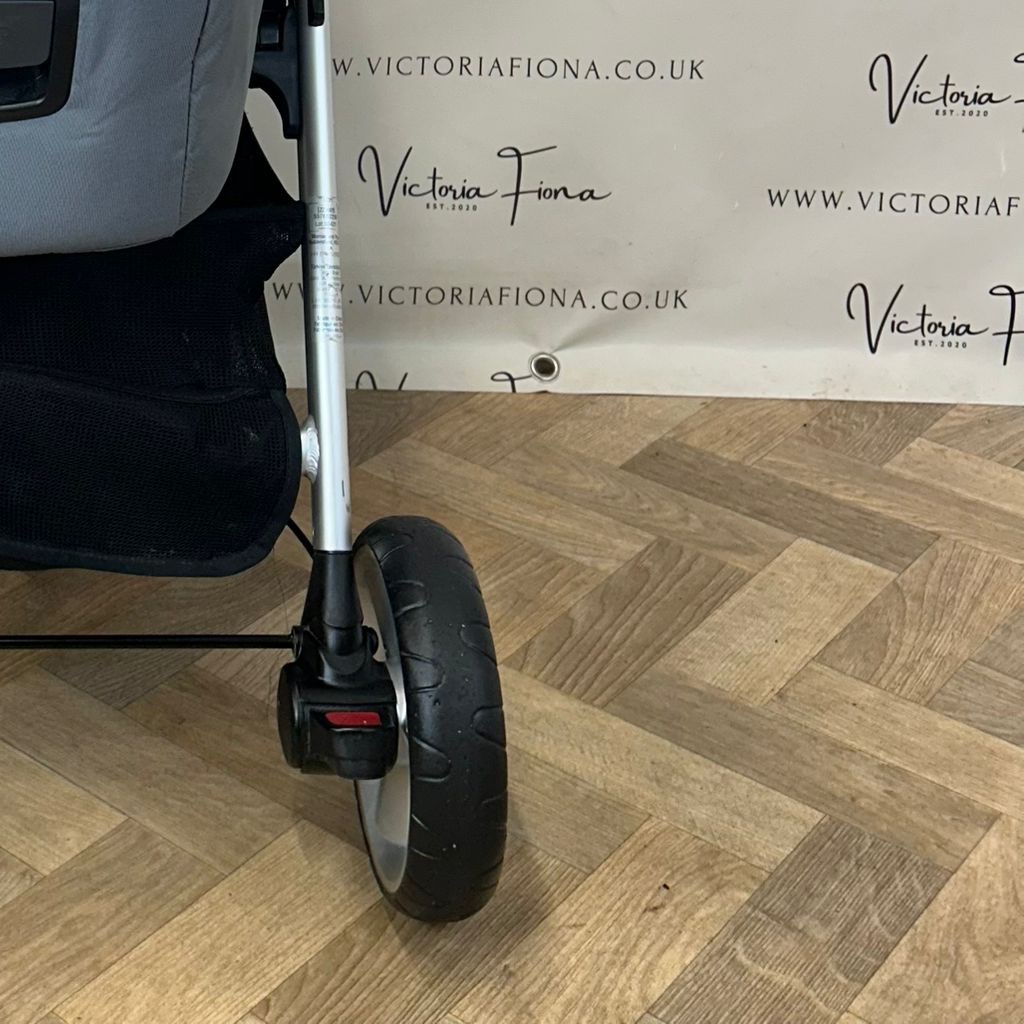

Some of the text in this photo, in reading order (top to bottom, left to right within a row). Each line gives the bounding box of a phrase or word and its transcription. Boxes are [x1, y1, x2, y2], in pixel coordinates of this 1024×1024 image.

[332, 56, 704, 80] W.VICTORIAFIONA.CO.UK
[869, 53, 1012, 124] Victoria
[358, 145, 612, 226] Victoria Fiona
[846, 282, 989, 355] Victoria
